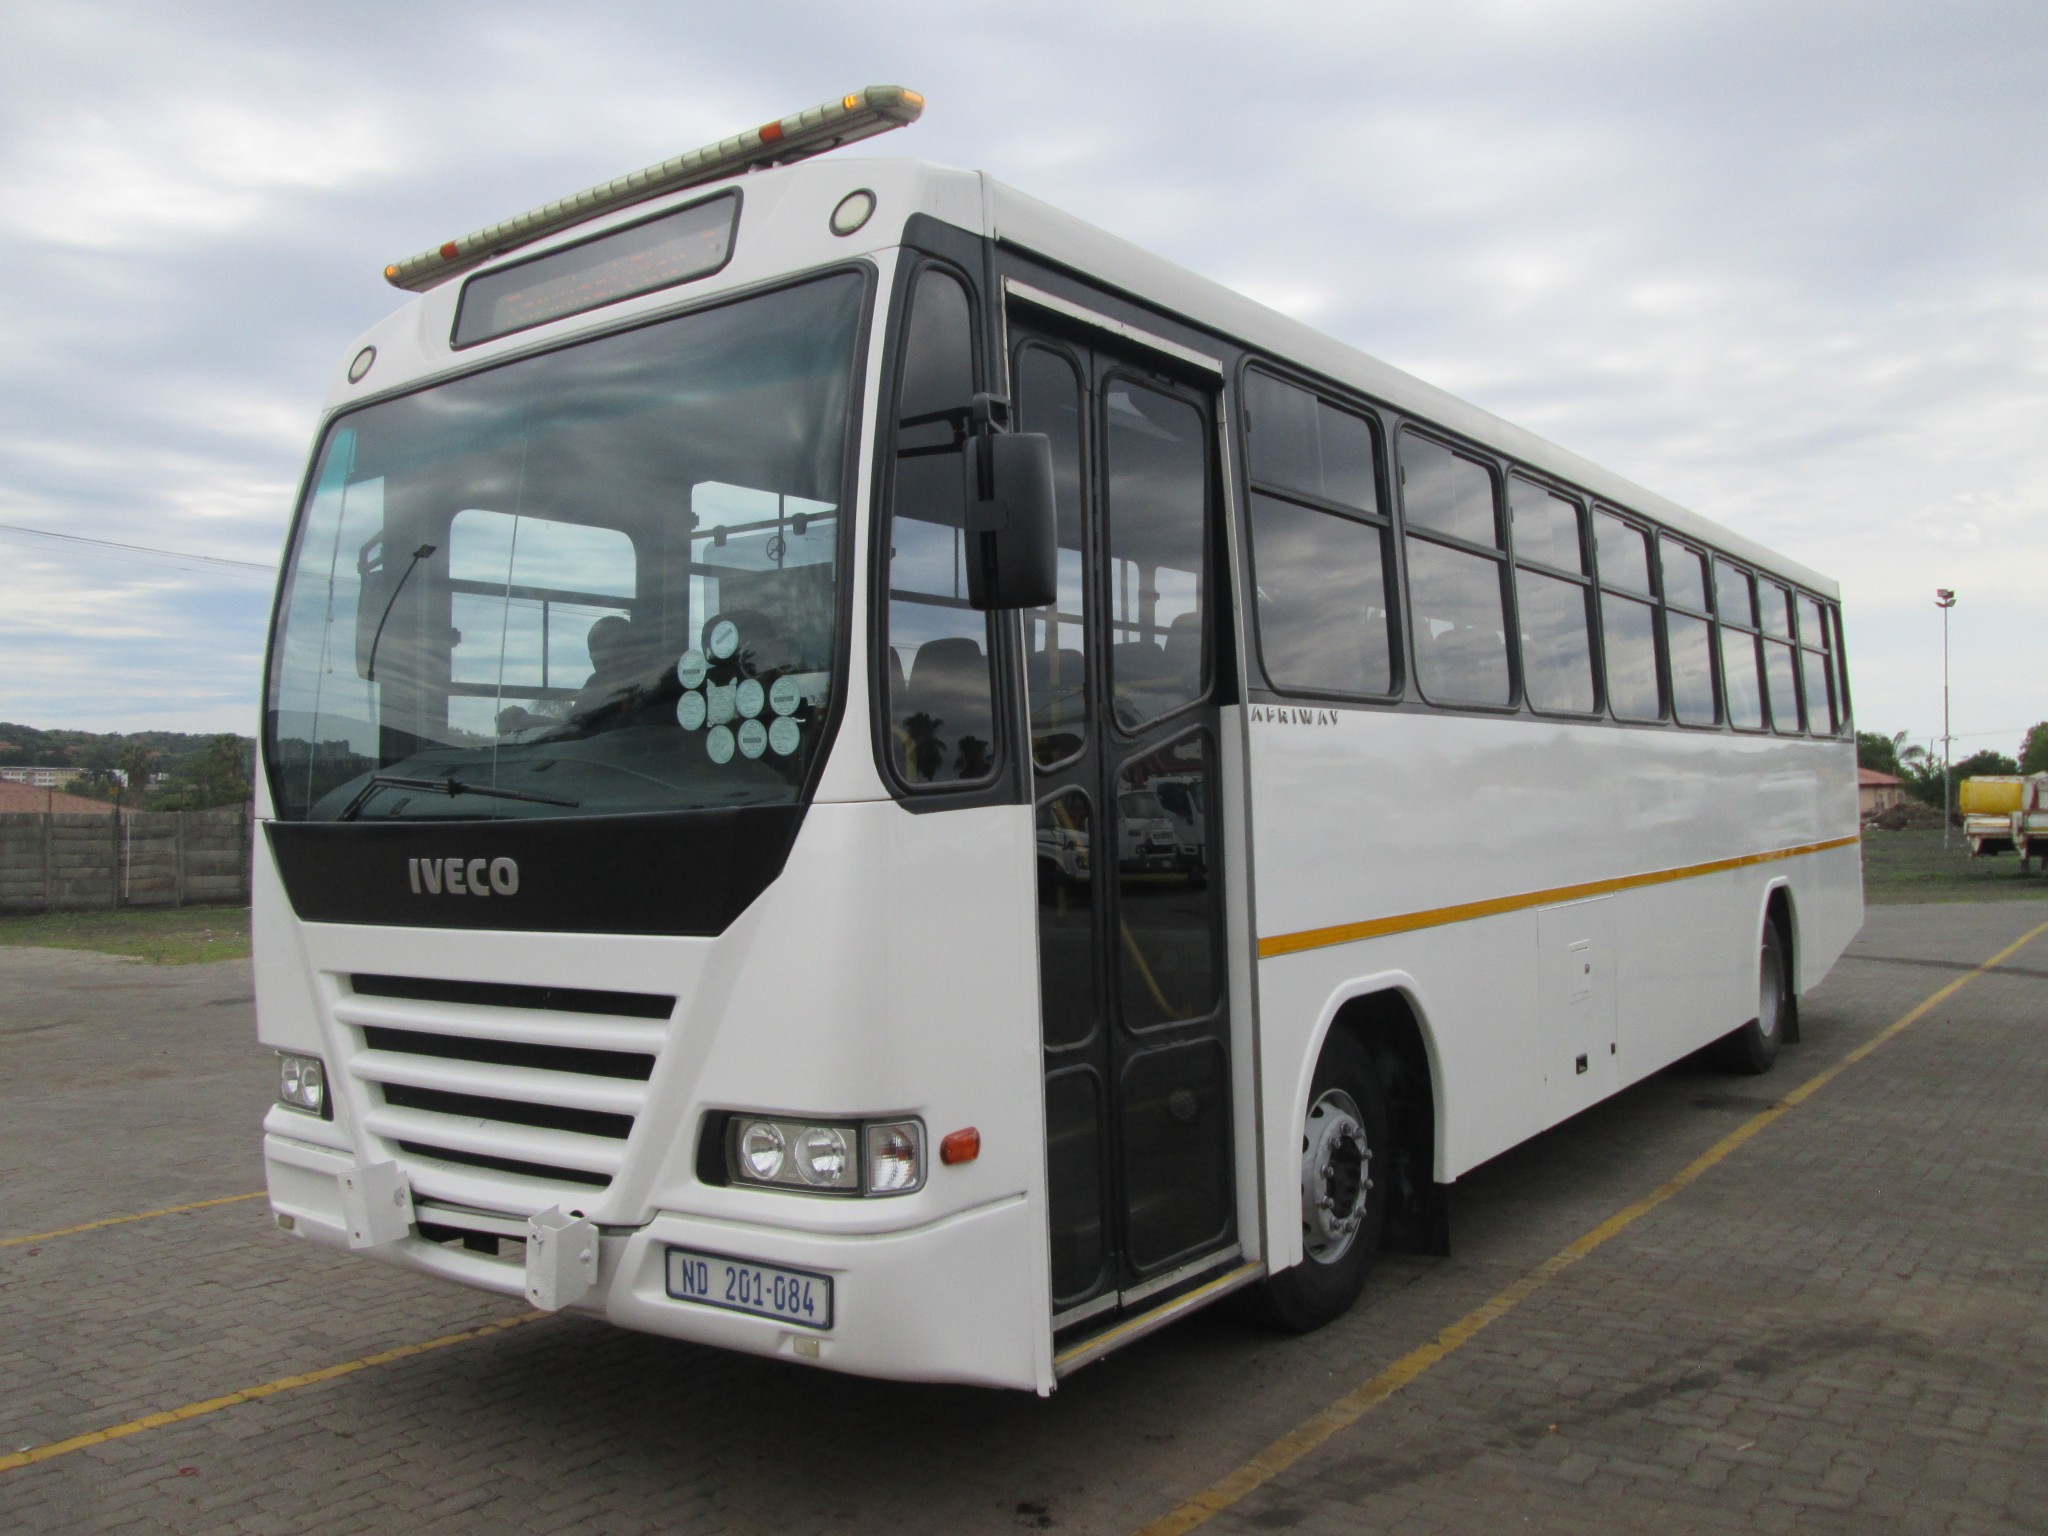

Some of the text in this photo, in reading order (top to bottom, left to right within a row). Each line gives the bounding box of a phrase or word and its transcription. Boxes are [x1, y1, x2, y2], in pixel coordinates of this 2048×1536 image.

[409, 857, 519, 896] IVECO
[682, 1259, 814, 1317] ND 201-084
